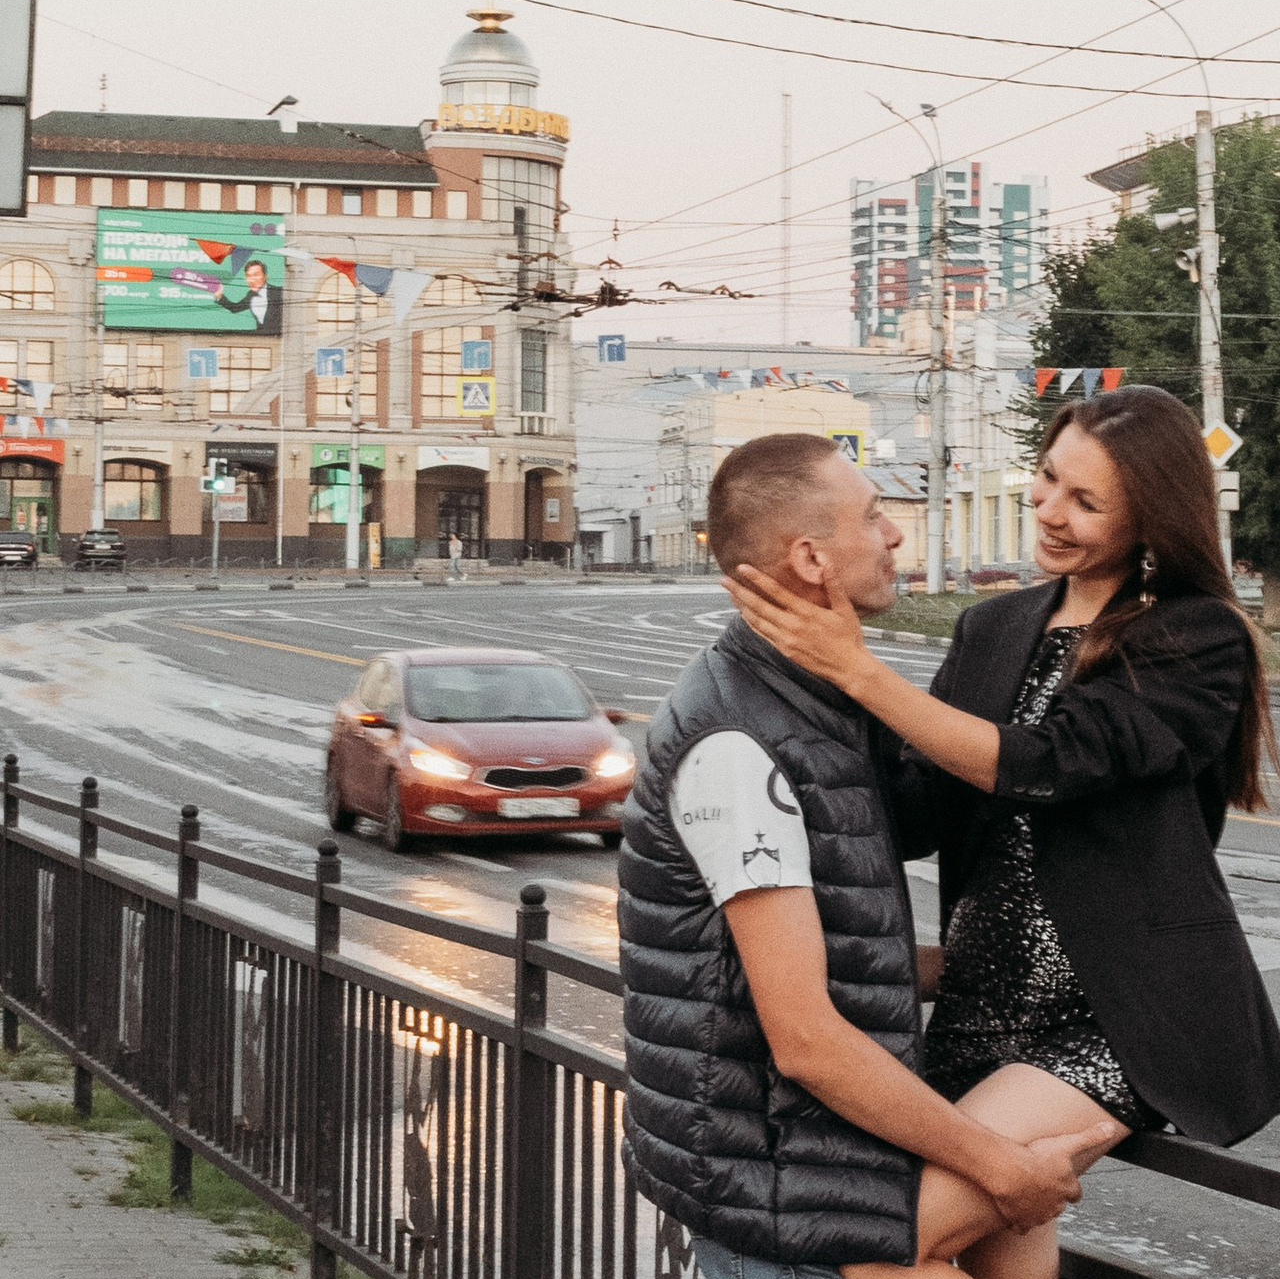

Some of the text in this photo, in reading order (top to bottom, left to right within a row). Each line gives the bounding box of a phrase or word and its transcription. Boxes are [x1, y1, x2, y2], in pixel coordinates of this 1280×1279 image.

[103, 232, 188, 248] ПЕРЕХОДИ
[103, 248, 211, 263] НА МЕГАТАРИ
